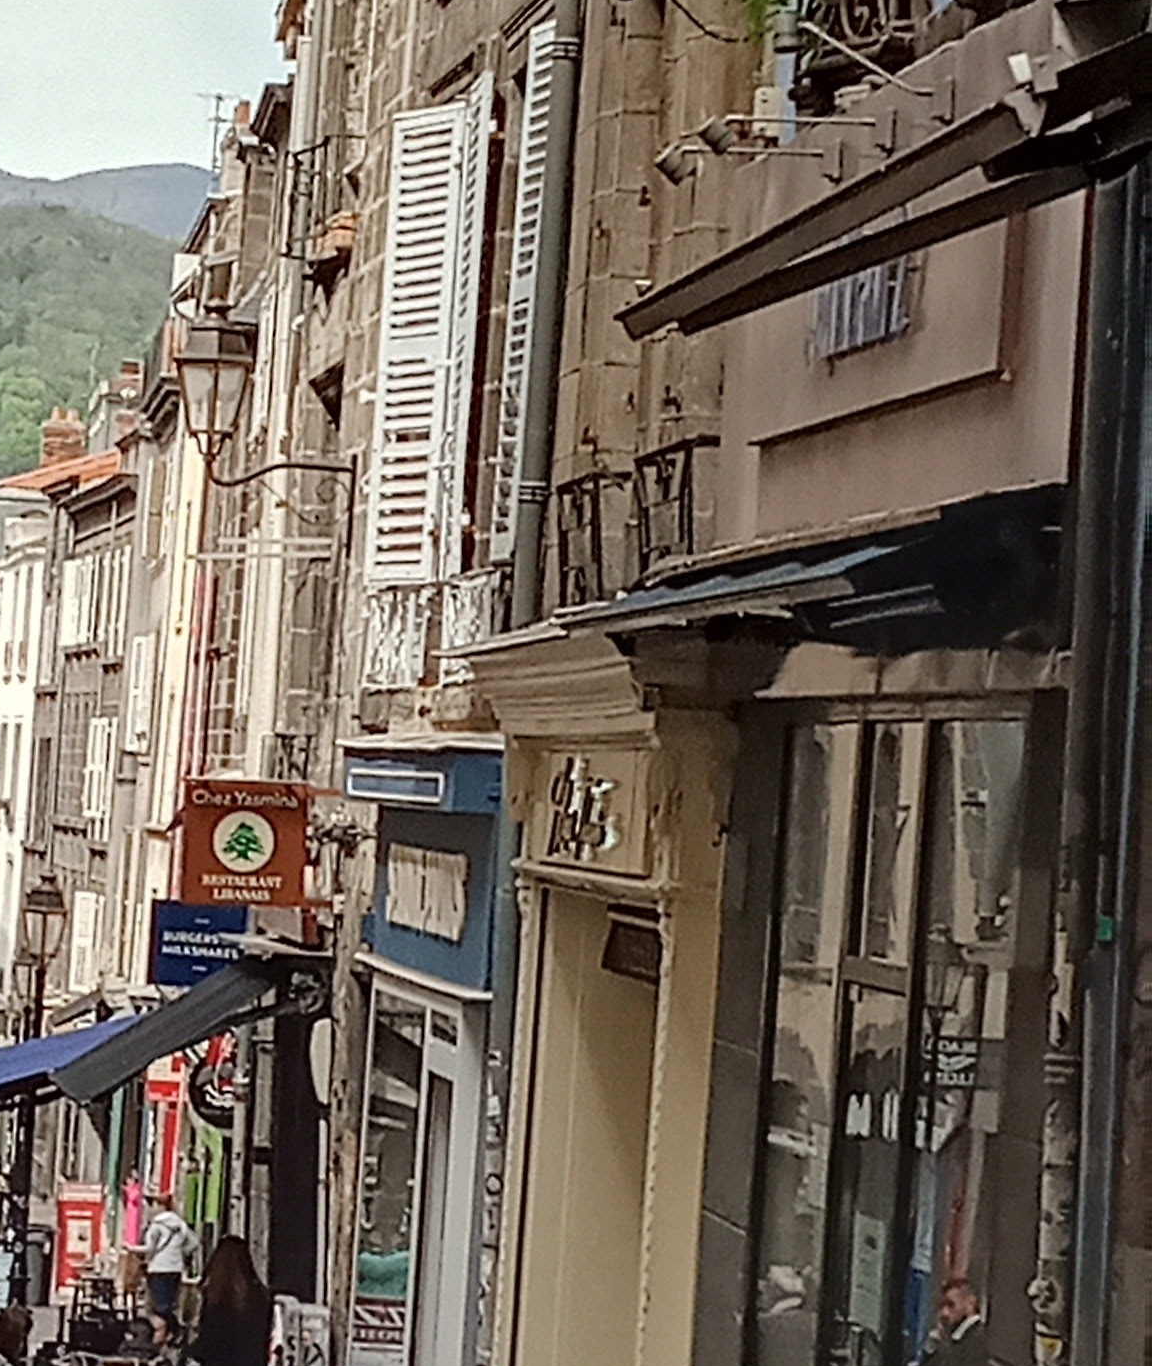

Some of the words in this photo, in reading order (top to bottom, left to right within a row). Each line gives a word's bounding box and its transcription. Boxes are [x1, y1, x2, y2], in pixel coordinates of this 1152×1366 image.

[192, 789, 232, 806] Chez
[234, 791, 299, 809] Yasmina
[202, 875, 282, 890] RESTAURANT
[213, 887, 271, 901] LIBANAIS
[163, 931, 219, 945] BURGERS
[161, 944, 239, 961] MILKSHAKES
